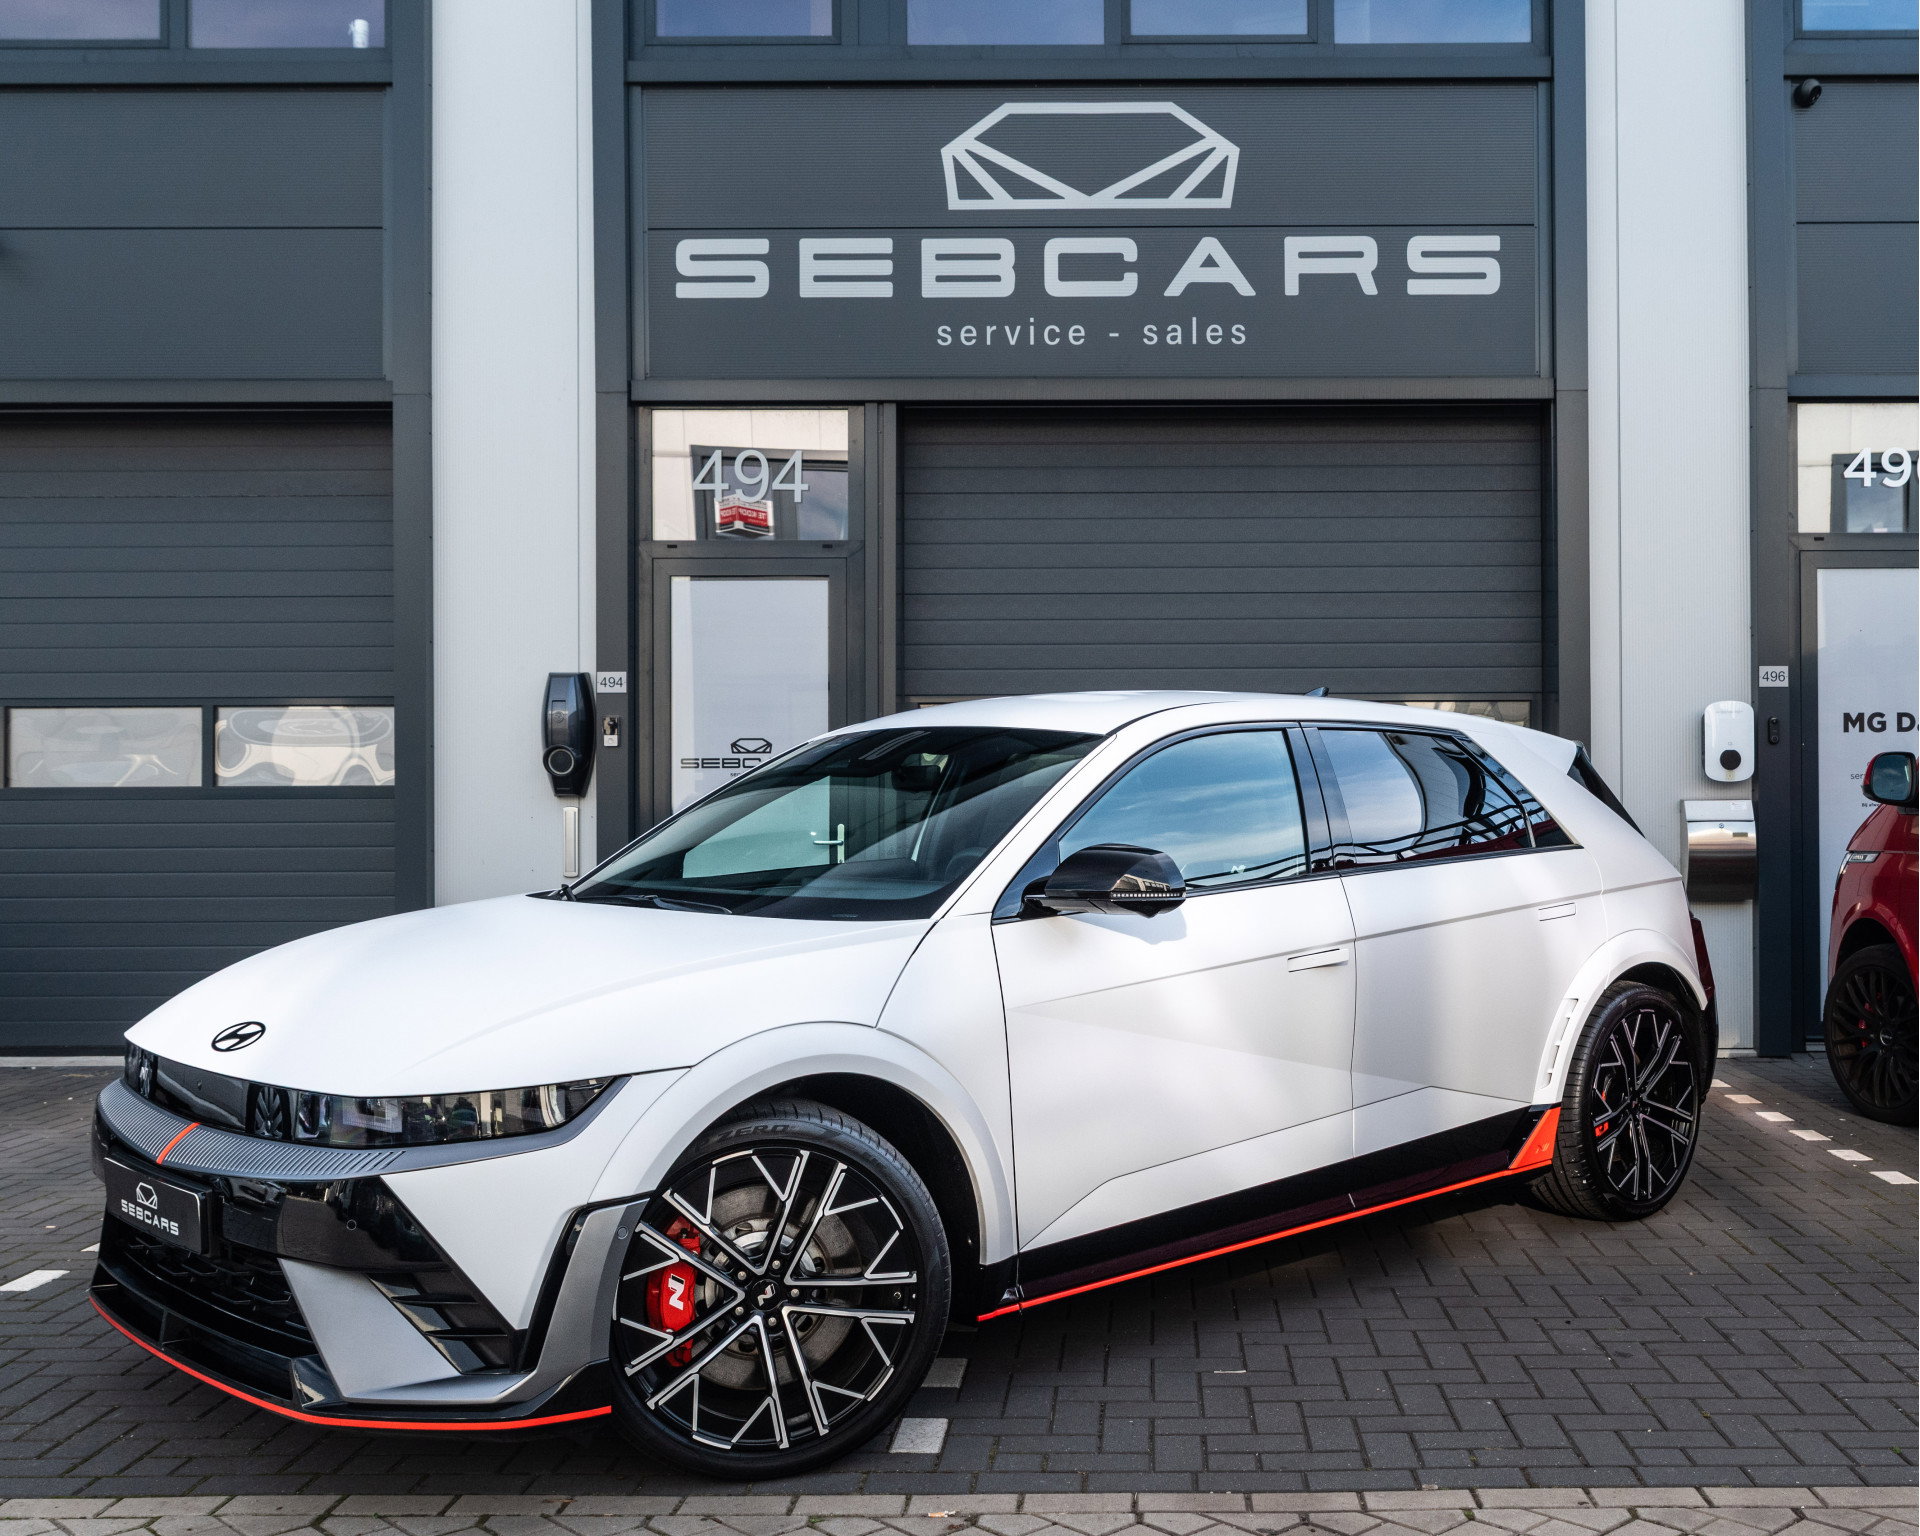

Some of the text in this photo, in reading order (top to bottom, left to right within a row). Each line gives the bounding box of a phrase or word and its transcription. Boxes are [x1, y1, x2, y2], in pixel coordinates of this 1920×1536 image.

[675, 235, 1501, 299] SEBCARS
[936, 318, 1086, 347] service
[1142, 317, 1247, 346] sales
[692, 449, 809, 503] 494
[1843, 447, 1919, 487] 49
[600, 676, 623, 688] 494
[1762, 670, 1786, 682] 496
[1843, 711, 1919, 733] MG D
[121, 1199, 179, 1236] SEBCARS
